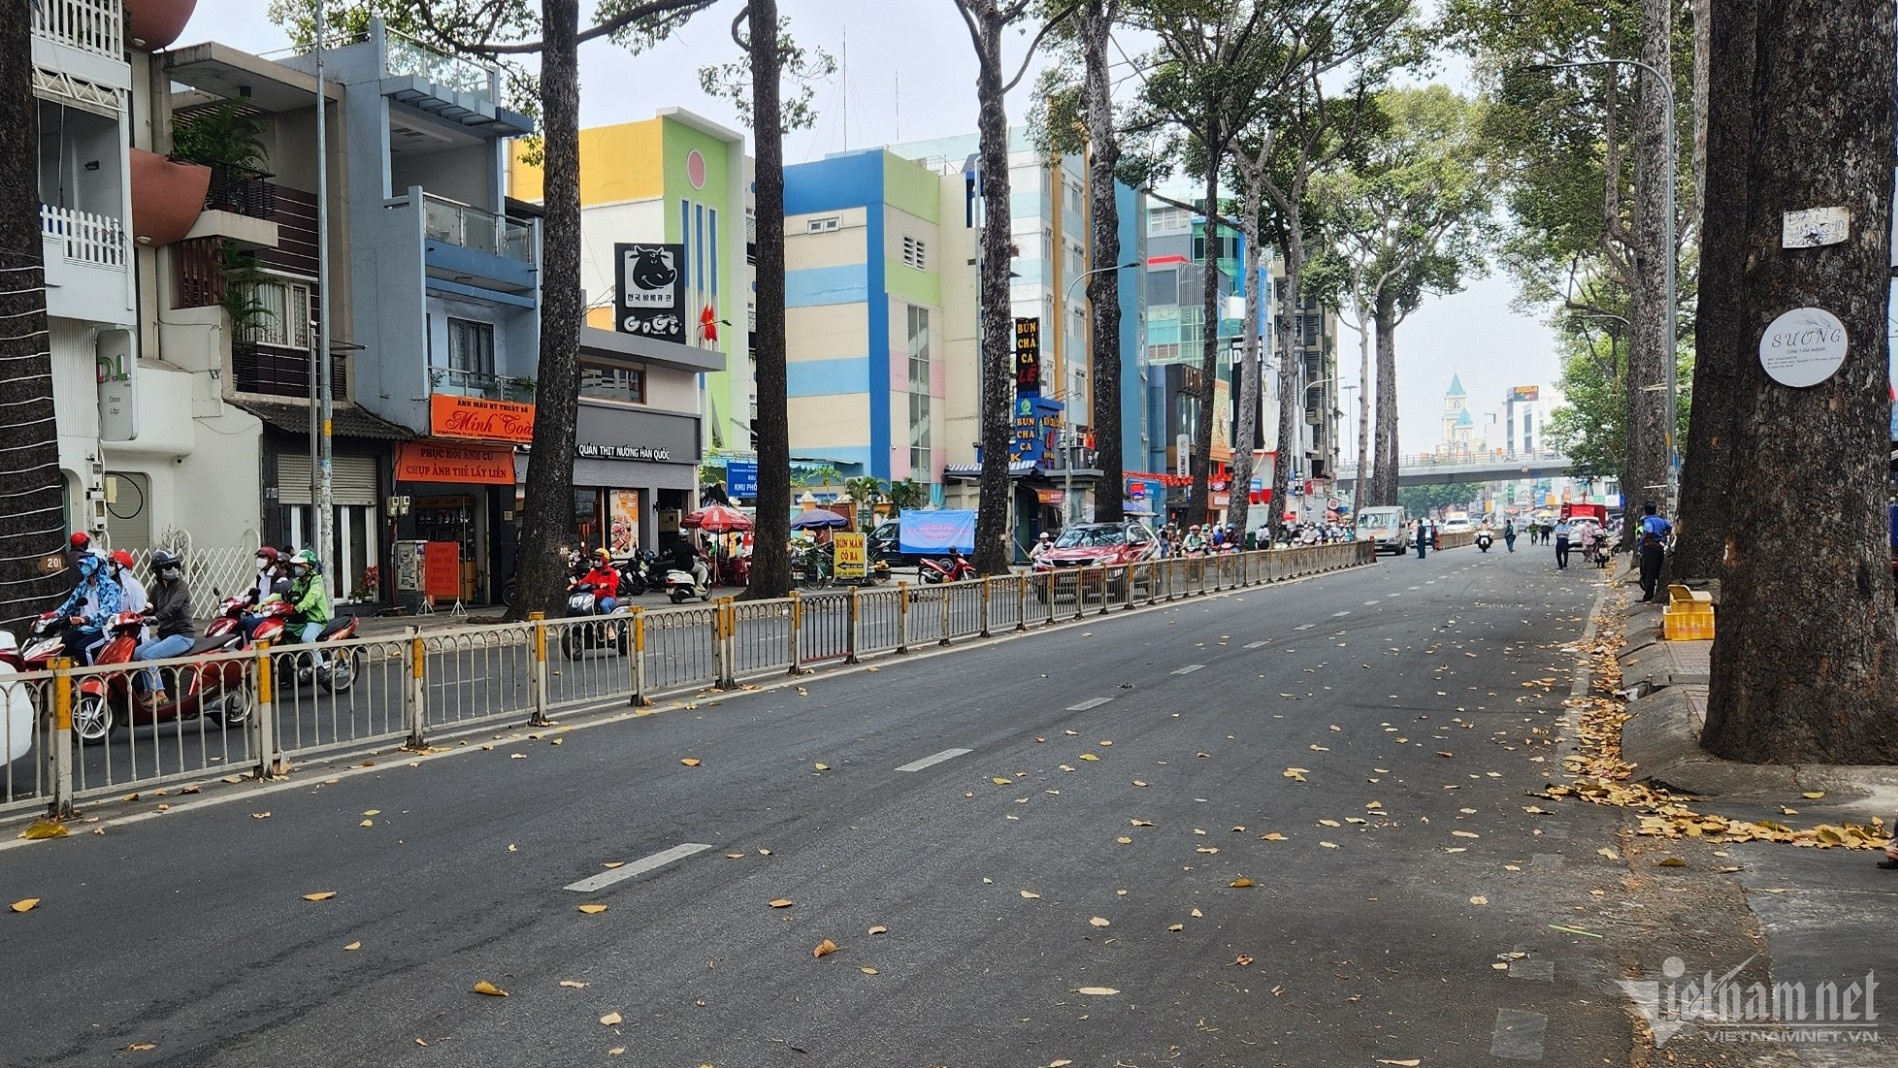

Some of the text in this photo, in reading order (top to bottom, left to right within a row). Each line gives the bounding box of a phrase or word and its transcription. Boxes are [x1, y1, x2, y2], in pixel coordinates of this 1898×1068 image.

[1017, 320, 1036, 334] BÚN
[1017, 333, 1036, 349] CHẢ
[1021, 350, 1034, 363] CÁ
[445, 410, 498, 433] Minh
[579, 443, 598, 457] QUÁN
[406, 465, 430, 478] CHỤP
[432, 463, 451, 476] ẢNH
[471, 465, 487, 478] LẤY
[734, 483, 746, 491] KHU
